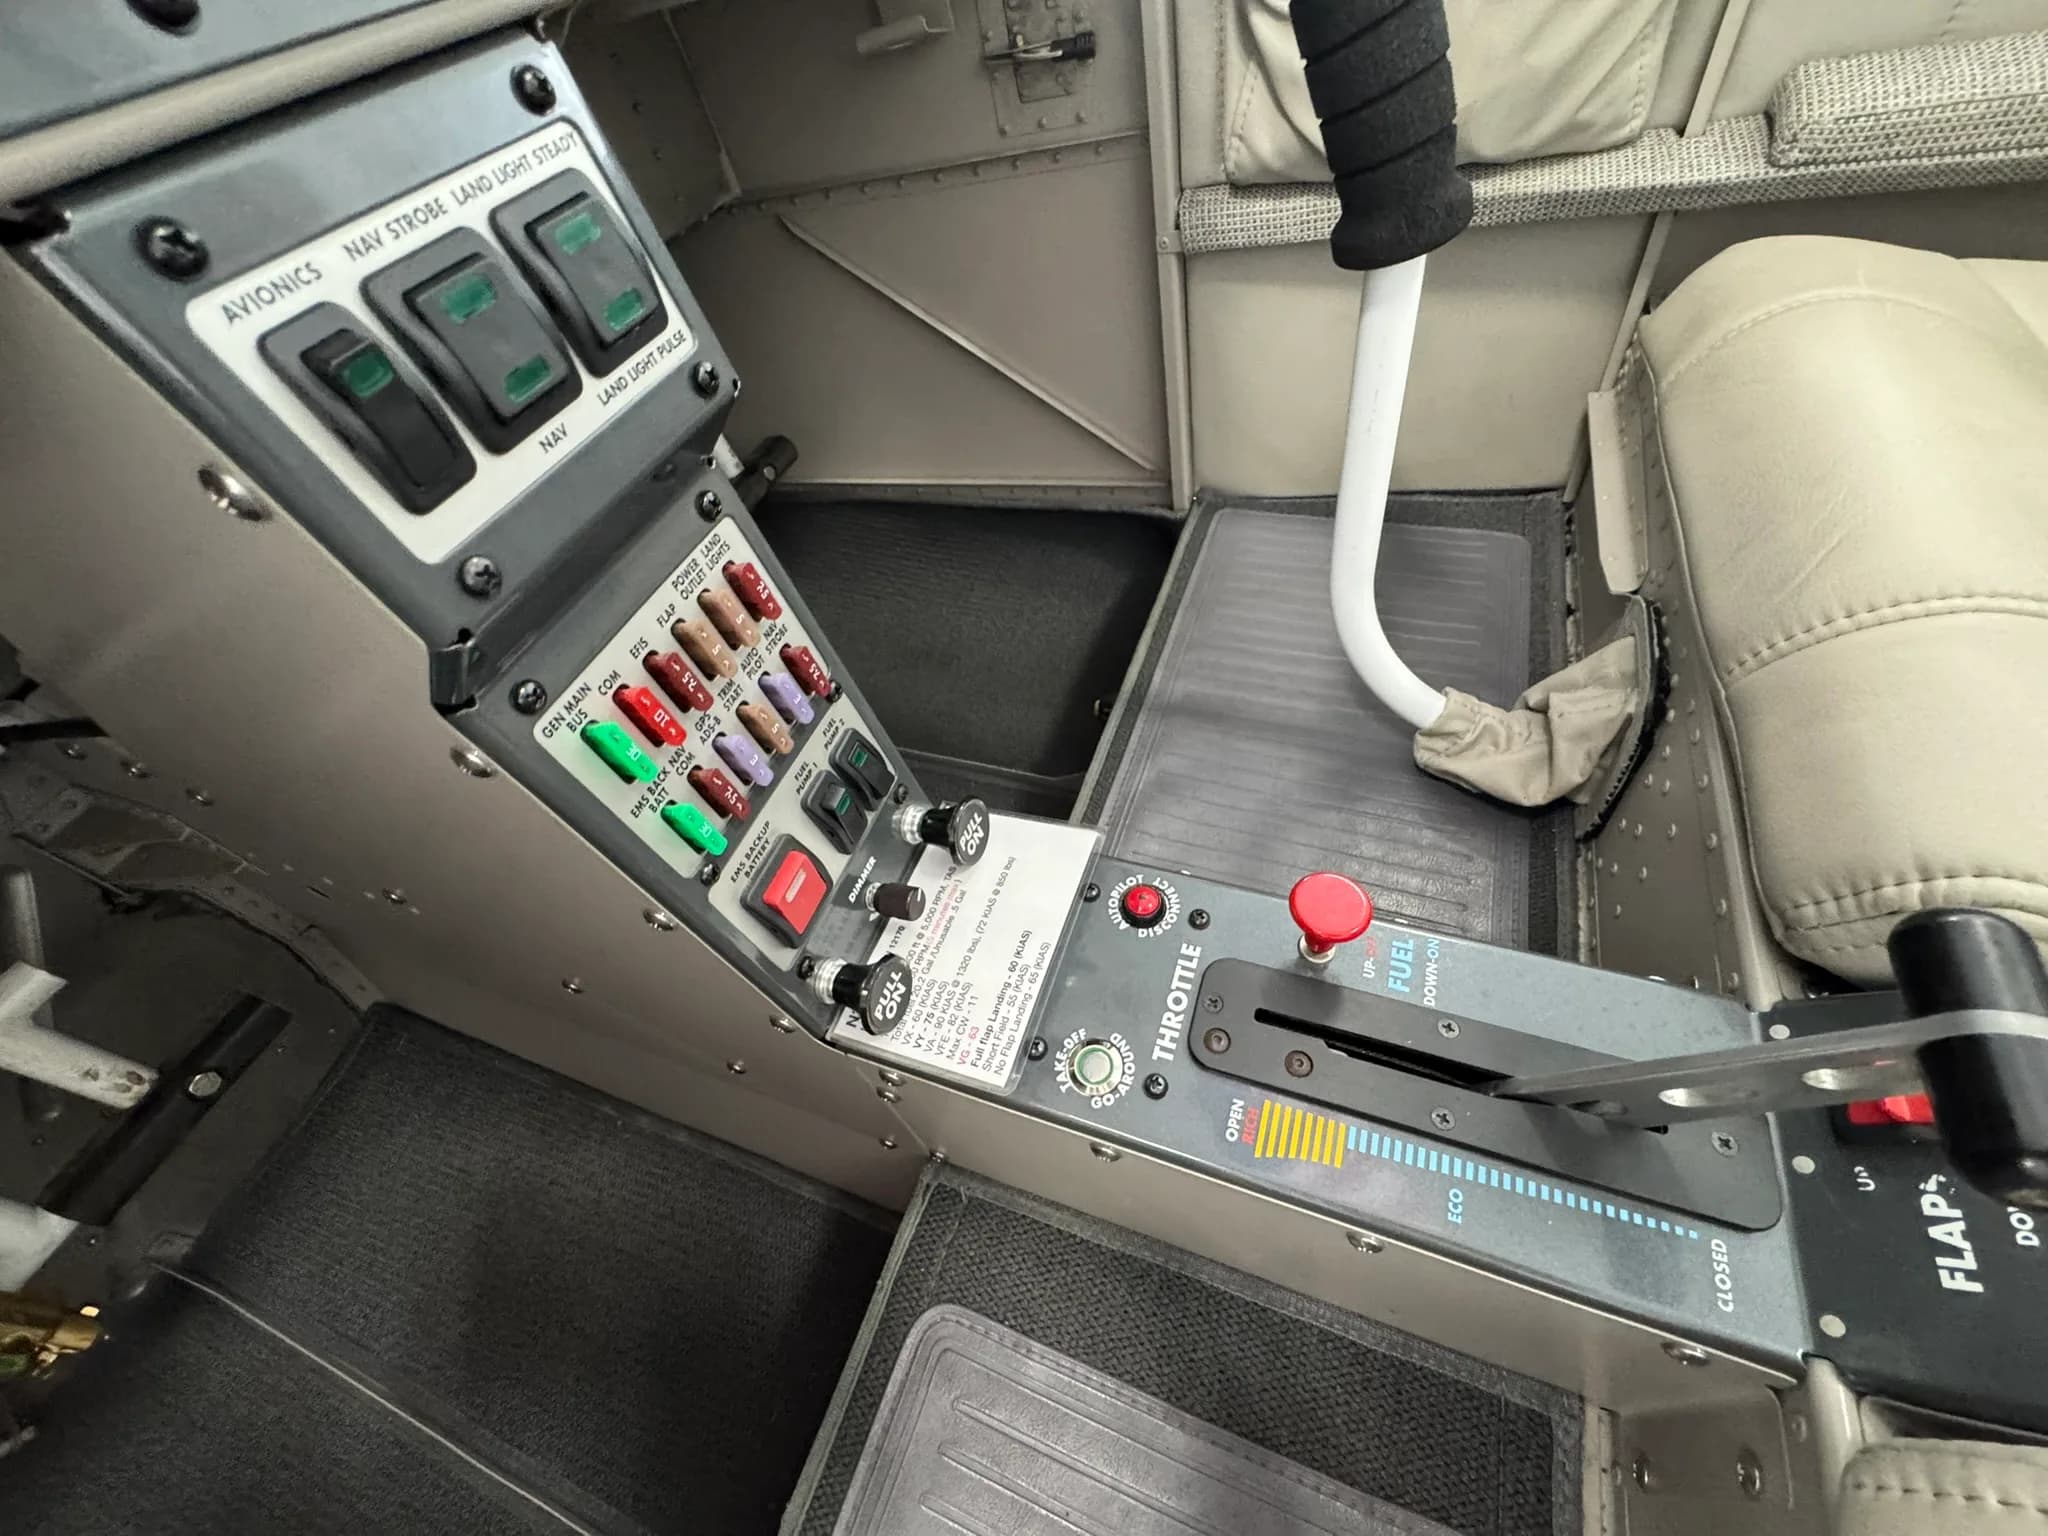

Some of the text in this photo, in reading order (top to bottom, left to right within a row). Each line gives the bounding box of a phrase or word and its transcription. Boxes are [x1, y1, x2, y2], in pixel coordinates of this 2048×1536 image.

[450, 131, 580, 206] LAND LIGHT STEADY
[342, 196, 449, 262] NAV STROBE
[220, 261, 324, 325] AVIONICS
[596, 329, 687, 406] LAND LIGHT PULSE
[538, 422, 568, 454] NAV
[700, 533, 722, 559] LAND
[706, 541, 731, 571] LIGHTS
[671, 558, 700, 591] POWER
[680, 568, 707, 600] OUTLET
[656, 603, 677, 628] FLAP
[763, 620, 779, 641] NAV
[629, 637, 649, 659] EFIS
[740, 647, 759, 672] AUTO
[598, 670, 621, 696] COM
[746, 656, 765, 680] PILOT
[717, 678, 736, 701] TRIM
[723, 685, 744, 712] START
[542, 683, 592, 738] GEN MAIN
[566, 708, 588, 733] BUS
[694, 712, 711, 732] GPS
[823, 718, 836, 737] FUEL
[700, 716, 722, 745] ADS-B
[824, 726, 841, 751] PUMP
[668, 744, 687, 768] NAV
[676, 752, 696, 776] COM
[794, 761, 809, 781] FUEL
[630, 767, 671, 818] EMS BACK
[648, 787, 669, 813] BATT
[796, 768, 813, 795] PUMP
[959, 812, 983, 850] PULL
[967, 826, 985, 856] ON
[731, 820, 770, 883] EMS BACKUP
[745, 838, 771, 879] BATTERY
[848, 856, 877, 904] DIMMER
[1108, 874, 1144, 930] AUTOPILOT
[1137, 877, 1181, 938] DISCONNECT
[916, 932, 925, 940] @
[921, 959, 934, 975] Gal
[923, 1039, 936, 1053] VA
[934, 1015, 946, 1029] 90
[940, 990, 957, 1015] KIAS
[951, 979, 960, 988] @
[956, 954, 972, 976] 1320
[981, 897, 997, 918] KIAS
[1388, 939, 1415, 993] FUEL
[1424, 938, 1440, 1007] DOWN-ON
[874, 971, 902, 1021] PULL
[885, 982, 906, 1019] ON
[901, 1031, 914, 1046] VX
[911, 1009, 923, 1022] 60
[919, 978, 938, 1008] (KIAS)
[912, 1034, 926, 1049] VY
[923, 1011, 935, 1025] 75
[930, 980, 950, 1011] (KIAS)
[970, 1046, 986, 1068] Full
[979, 1024, 995, 1046] flap
[988, 981, 1012, 1023] Landing
[1007, 960, 1019, 973] 60
[1013, 930, 1032, 959] (KIAS)
[993, 1059, 1007, 1076] No
[1000, 1034, 1016, 1058] Flap
[1010, 992, 1033, 1033] Landing
[1028, 971, 1039, 984] 65
[1034, 941, 1052, 970] (KIAS)
[1152, 942, 1202, 1062] THROTTLE
[934, 1034, 950, 1056] VFE
[948, 1013, 958, 1026] 82
[953, 982, 973, 1012] (KIAS)
[945, 1038, 961, 1060] Max
[956, 1016, 969, 1036] CW
[968, 995, 979, 1007] 11
[982, 1042, 1000, 1072] Short
[993, 1016, 1009, 1040] Field
[1007, 994, 1018, 1008] 55
[1013, 964, 1032, 993] (KIAS)
[956, 1049, 970, 1065] VG
[968, 1025, 980, 1040] 63
[1054, 1028, 1087, 1093] TAKE-OFF
[1090, 1033, 1136, 1109] GO-AROUND
[1225, 1098, 1245, 1142] OPEN
[1448, 1188, 1464, 1224] ECO
[1711, 1238, 1735, 1313] CLOSED
